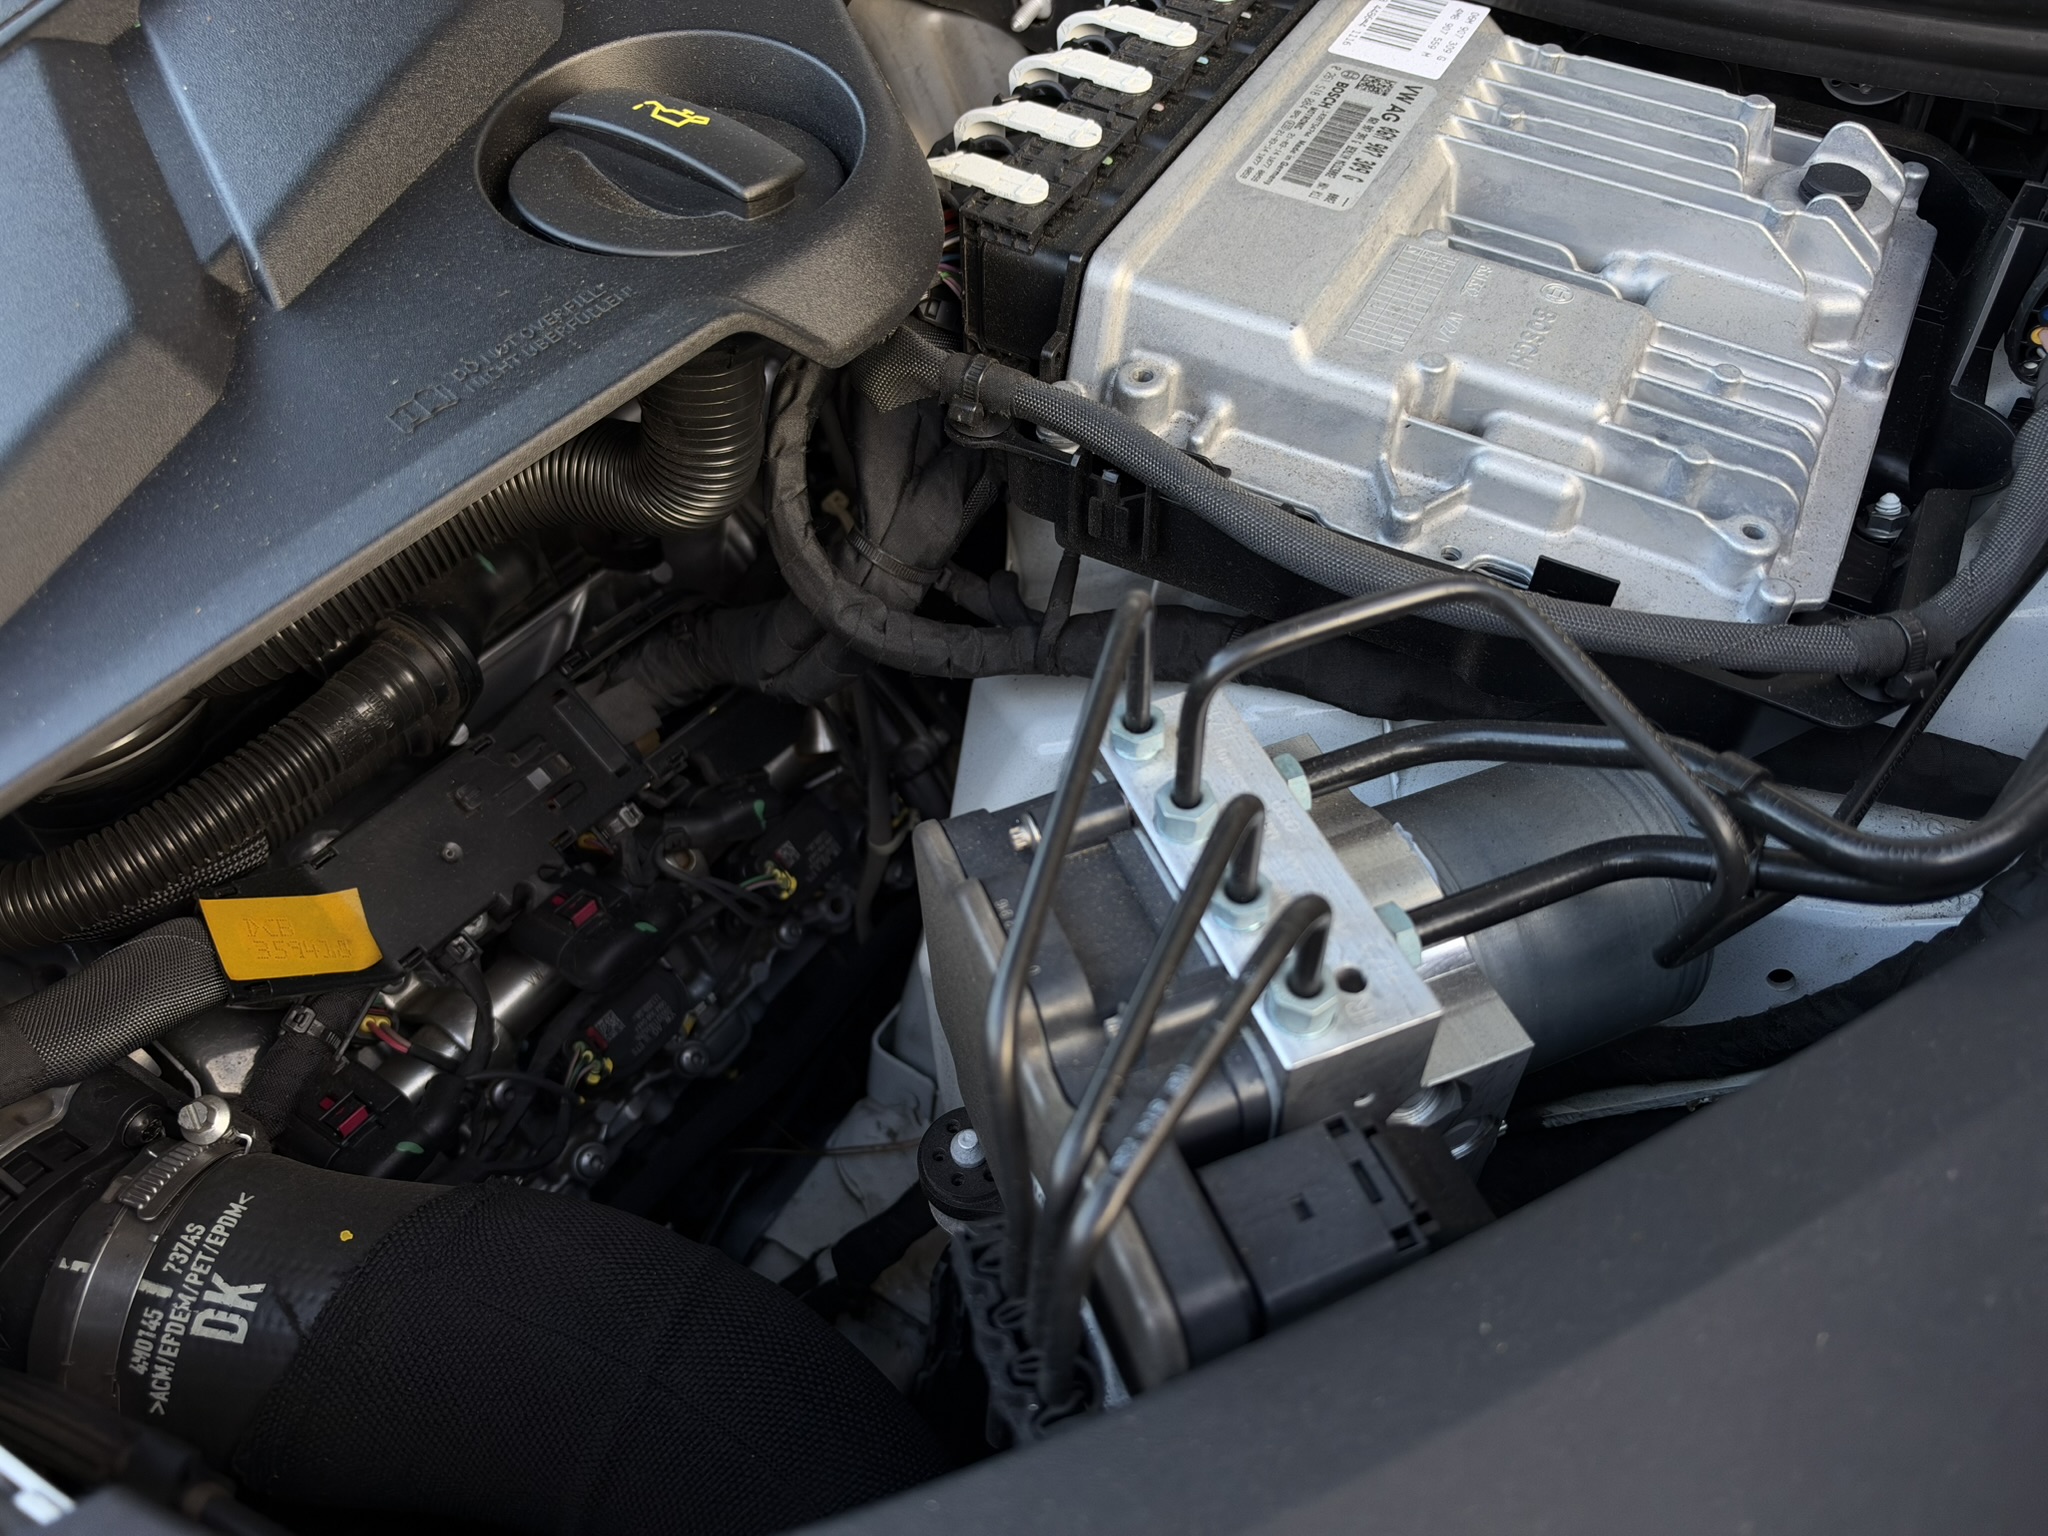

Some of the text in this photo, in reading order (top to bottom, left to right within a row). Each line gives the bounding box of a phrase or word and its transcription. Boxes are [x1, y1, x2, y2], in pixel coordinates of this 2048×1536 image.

[1437, 22, 1454, 34] 907
[1452, 26, 1470, 38] 907
[1441, 40, 1458, 53] 309
[1319, 71, 1336, 82] 261
[1317, 80, 1349, 109] BOSCH
[1393, 83, 1423, 104] VW
[1379, 103, 1408, 123] AG
[1288, 139, 1306, 154] Made
[1359, 141, 1389, 158] 907
[1261, 160, 1289, 186] Germany
[1347, 157, 1376, 174] 309
[1340, 173, 1365, 183] G
[1506, 307, 1558, 371] BOSCH
[162, 1222, 206, 1275] 737AS
[189, 1272, 267, 1345] DK
